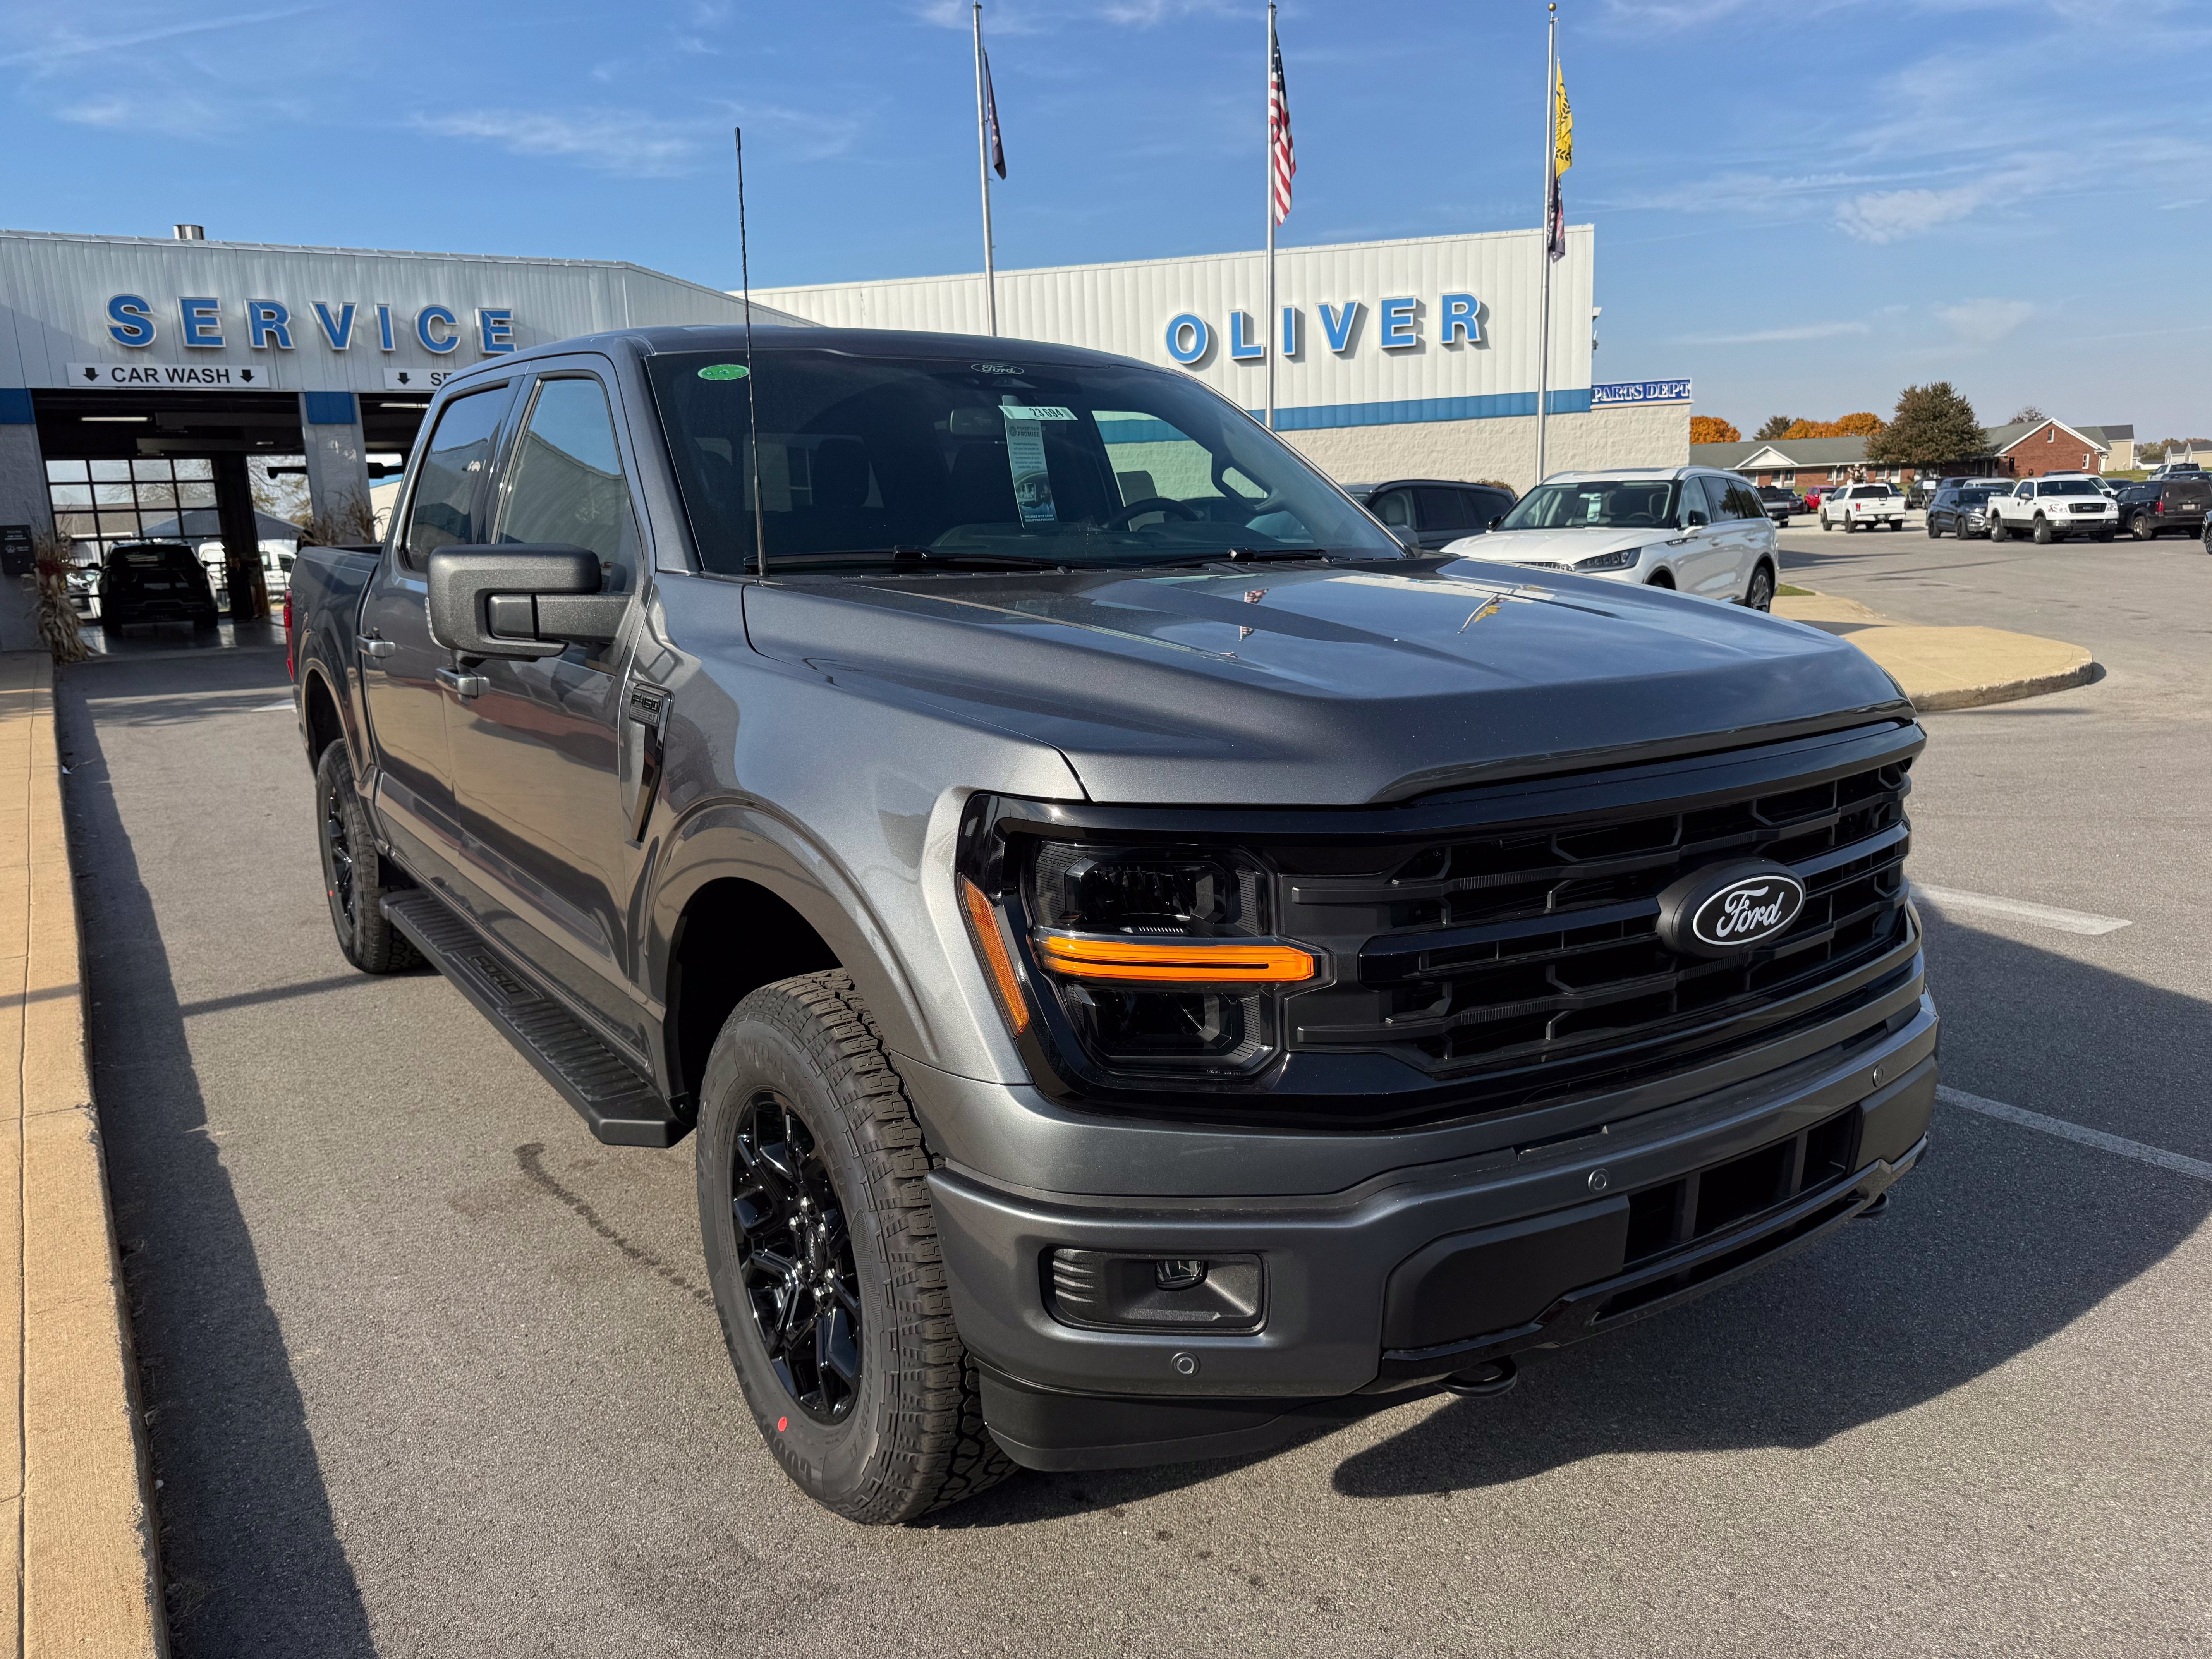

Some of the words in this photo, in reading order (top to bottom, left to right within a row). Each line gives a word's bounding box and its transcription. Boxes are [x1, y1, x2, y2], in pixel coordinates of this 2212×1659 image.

[106, 293, 518, 355] SERVICE
[1165, 292, 1482, 364] OLIVER
[111, 366, 160, 384] CAR
[165, 368, 230, 384] WASH
[982, 364, 1016, 373] Ford
[431, 372, 452, 386] S
[1591, 385, 1644, 402] PARTS
[1646, 382, 1690, 398] DEPT
[1039, 858, 1066, 868] FORD
[1716, 886, 1785, 937] Ford
[470, 955, 525, 994] FORD
